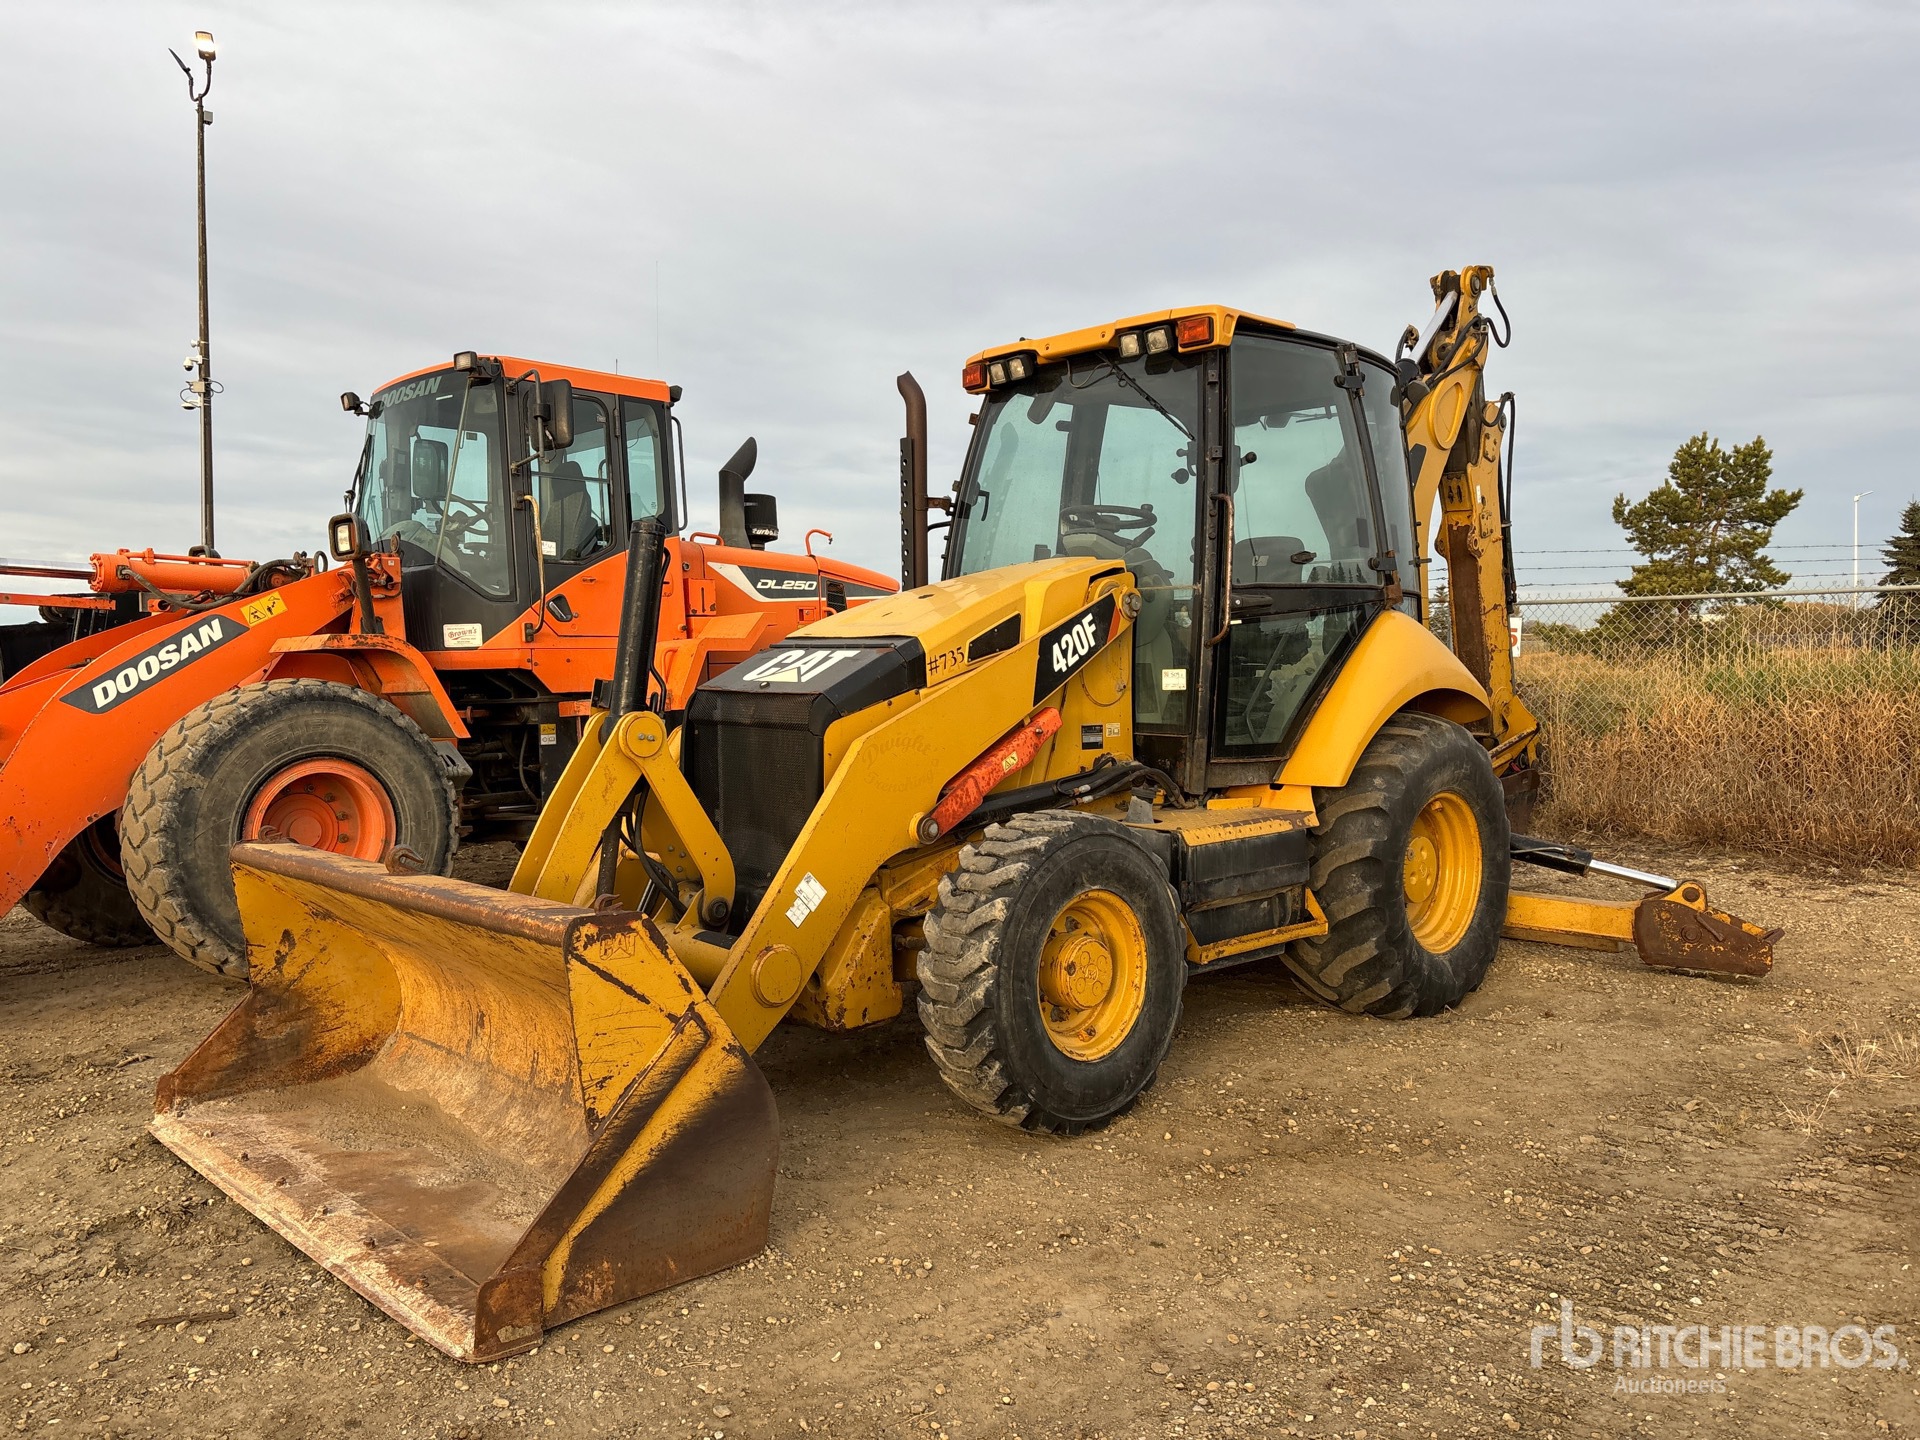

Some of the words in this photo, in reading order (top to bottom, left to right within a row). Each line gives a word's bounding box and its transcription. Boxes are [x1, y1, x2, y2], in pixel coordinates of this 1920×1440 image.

[379, 376, 443, 411] DOOSAN
[757, 579, 818, 590] DL250
[1052, 613, 1097, 673] 420F
[92, 618, 223, 709] DOOSAN
[742, 649, 862, 683] CAT
[927, 646, 965, 676] #735
[600, 932, 639, 960] CAT
